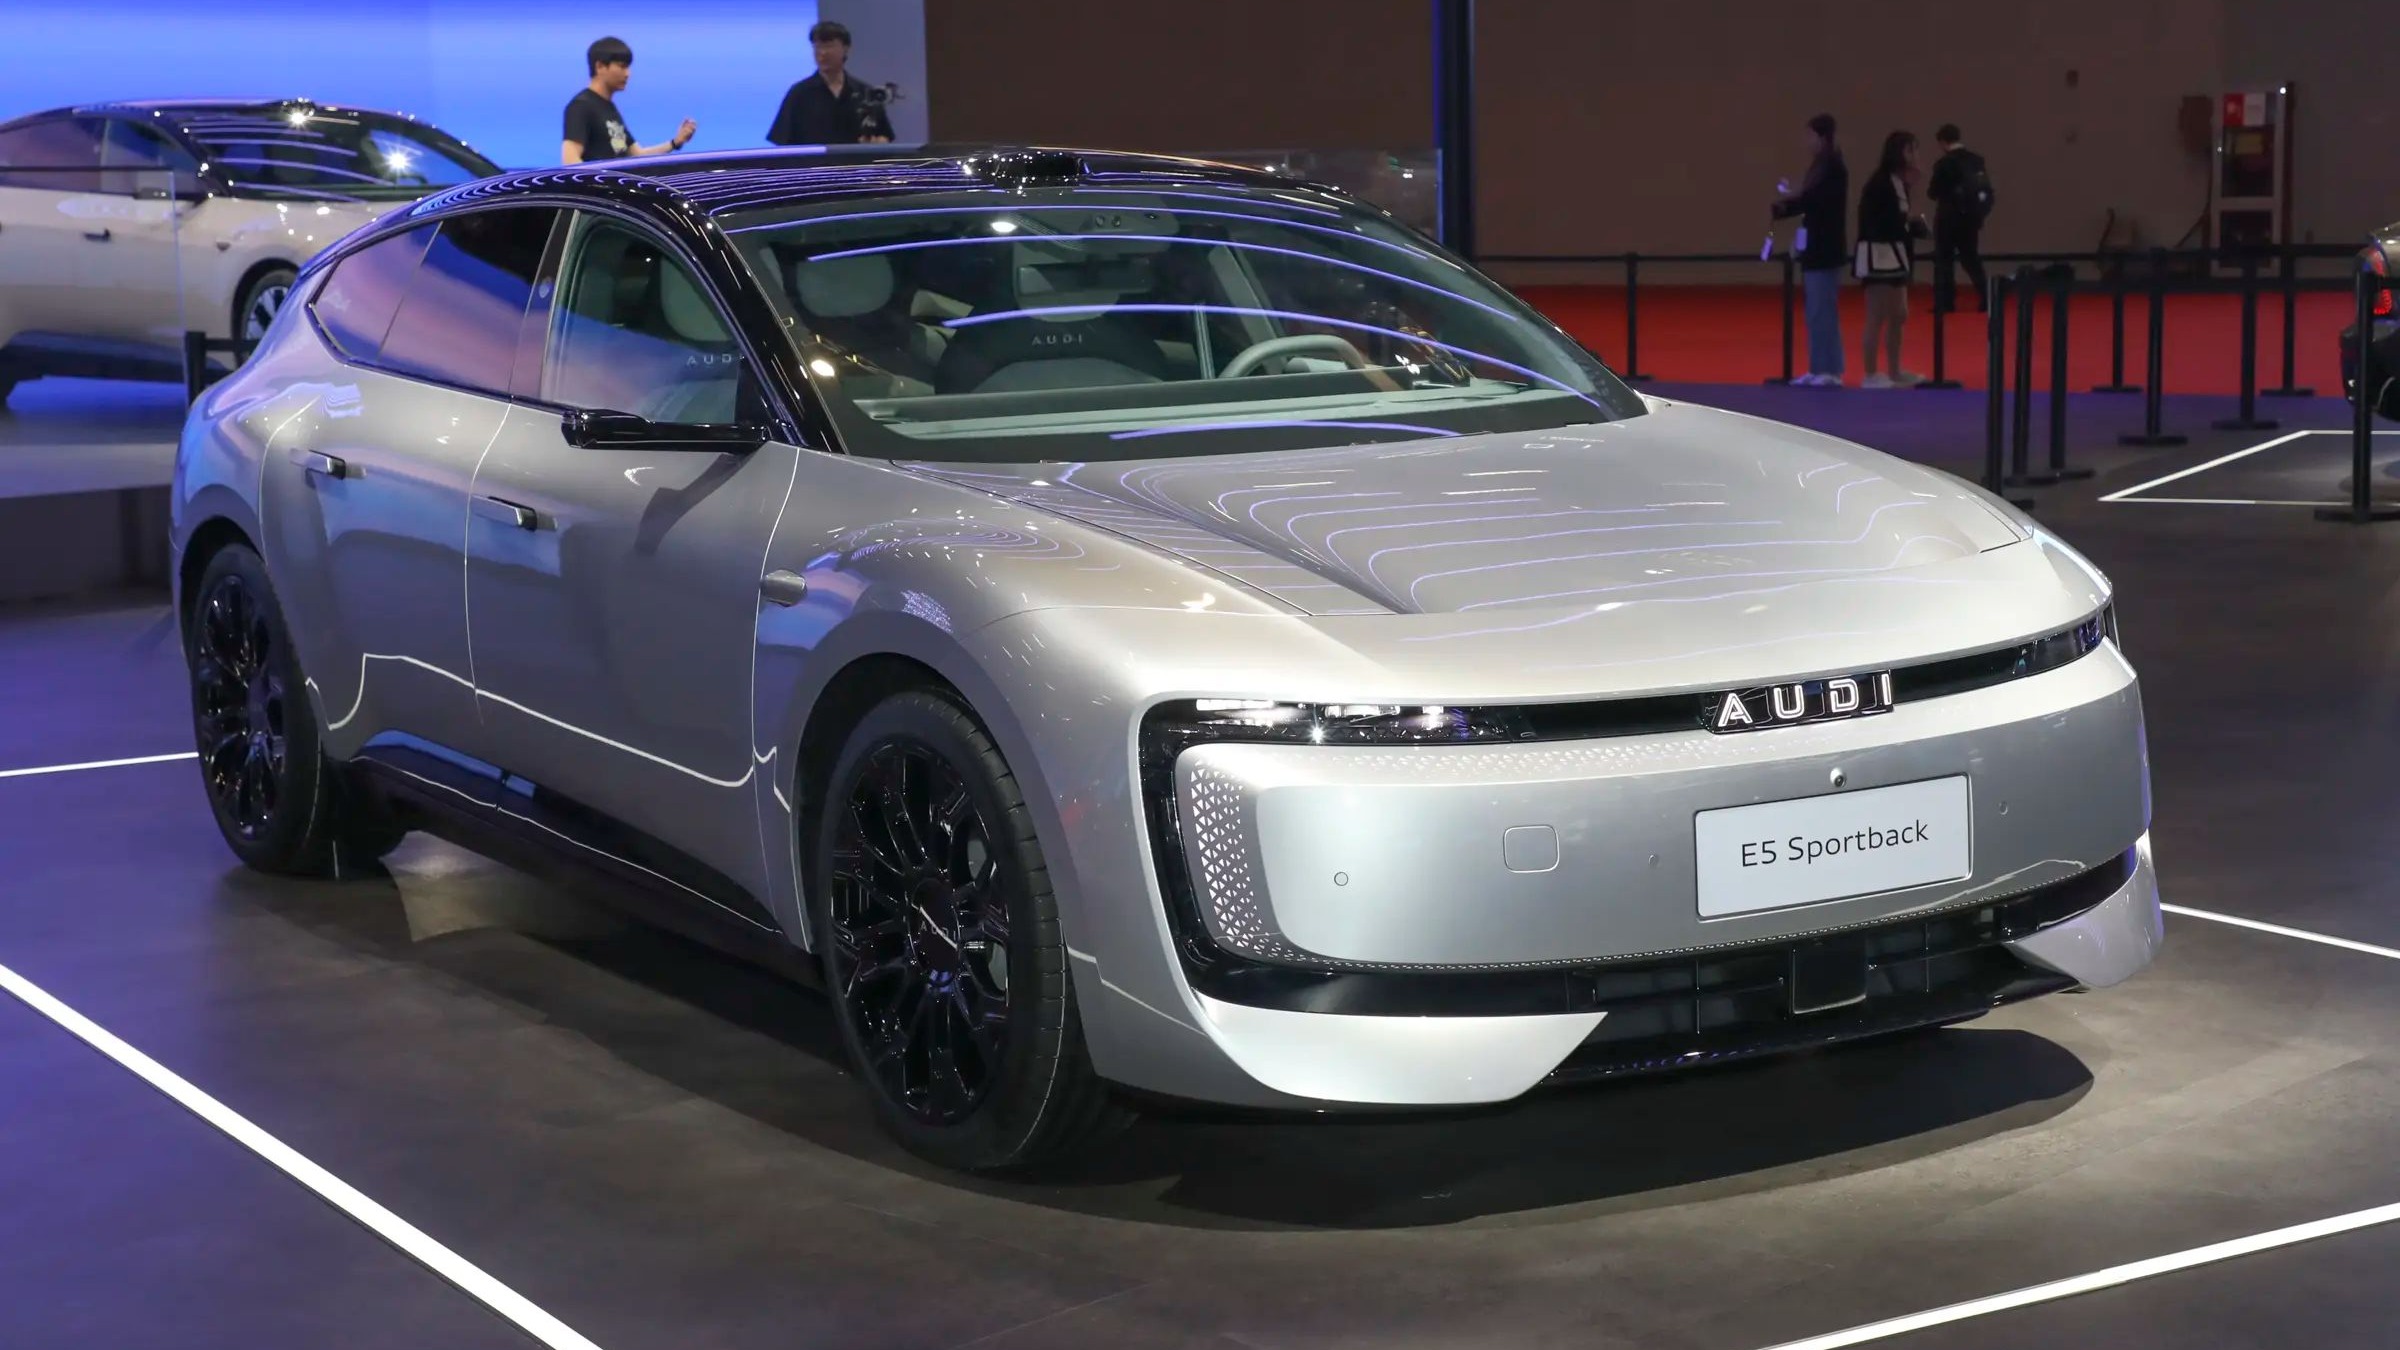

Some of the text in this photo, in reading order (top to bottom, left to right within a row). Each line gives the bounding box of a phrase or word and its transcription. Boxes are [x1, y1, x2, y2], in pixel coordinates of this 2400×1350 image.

[1031, 333, 1083, 346] AUDI
[686, 353, 741, 367] AUD
[1717, 673, 1892, 728] AUDI
[1741, 818, 1930, 868] E5 Sportback
